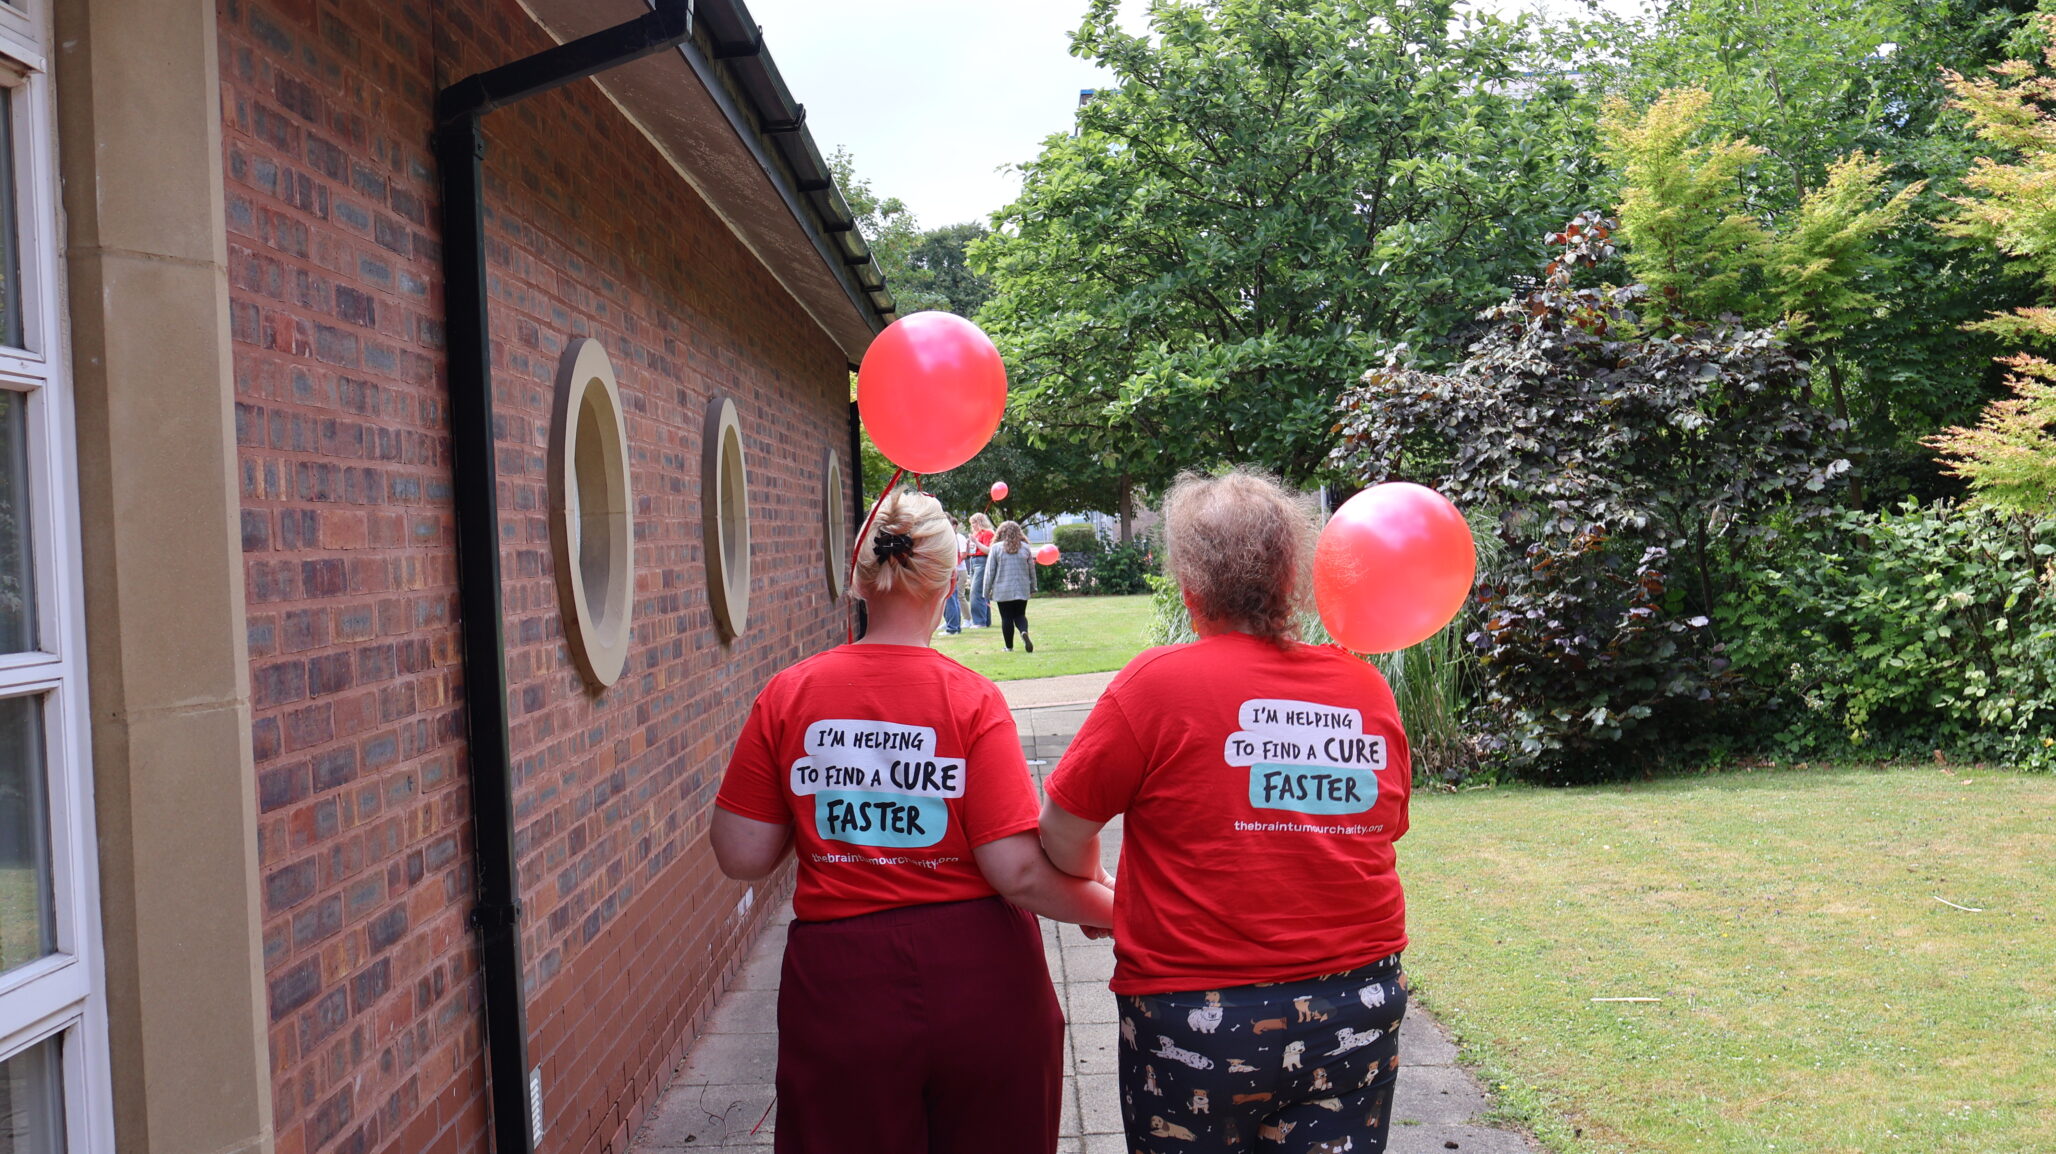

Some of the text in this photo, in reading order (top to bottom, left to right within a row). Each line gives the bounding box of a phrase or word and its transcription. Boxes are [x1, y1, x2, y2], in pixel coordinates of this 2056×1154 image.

[1252, 706, 1352, 730] I'M HELPING
[817, 728, 924, 751] I'M HELPING
[1232, 737, 1380, 764] TO FIND A CURE
[797, 760, 959, 791] TO FIND A CURE
[1263, 771, 1361, 803] FASTER
[827, 798, 925, 835] FASTER
